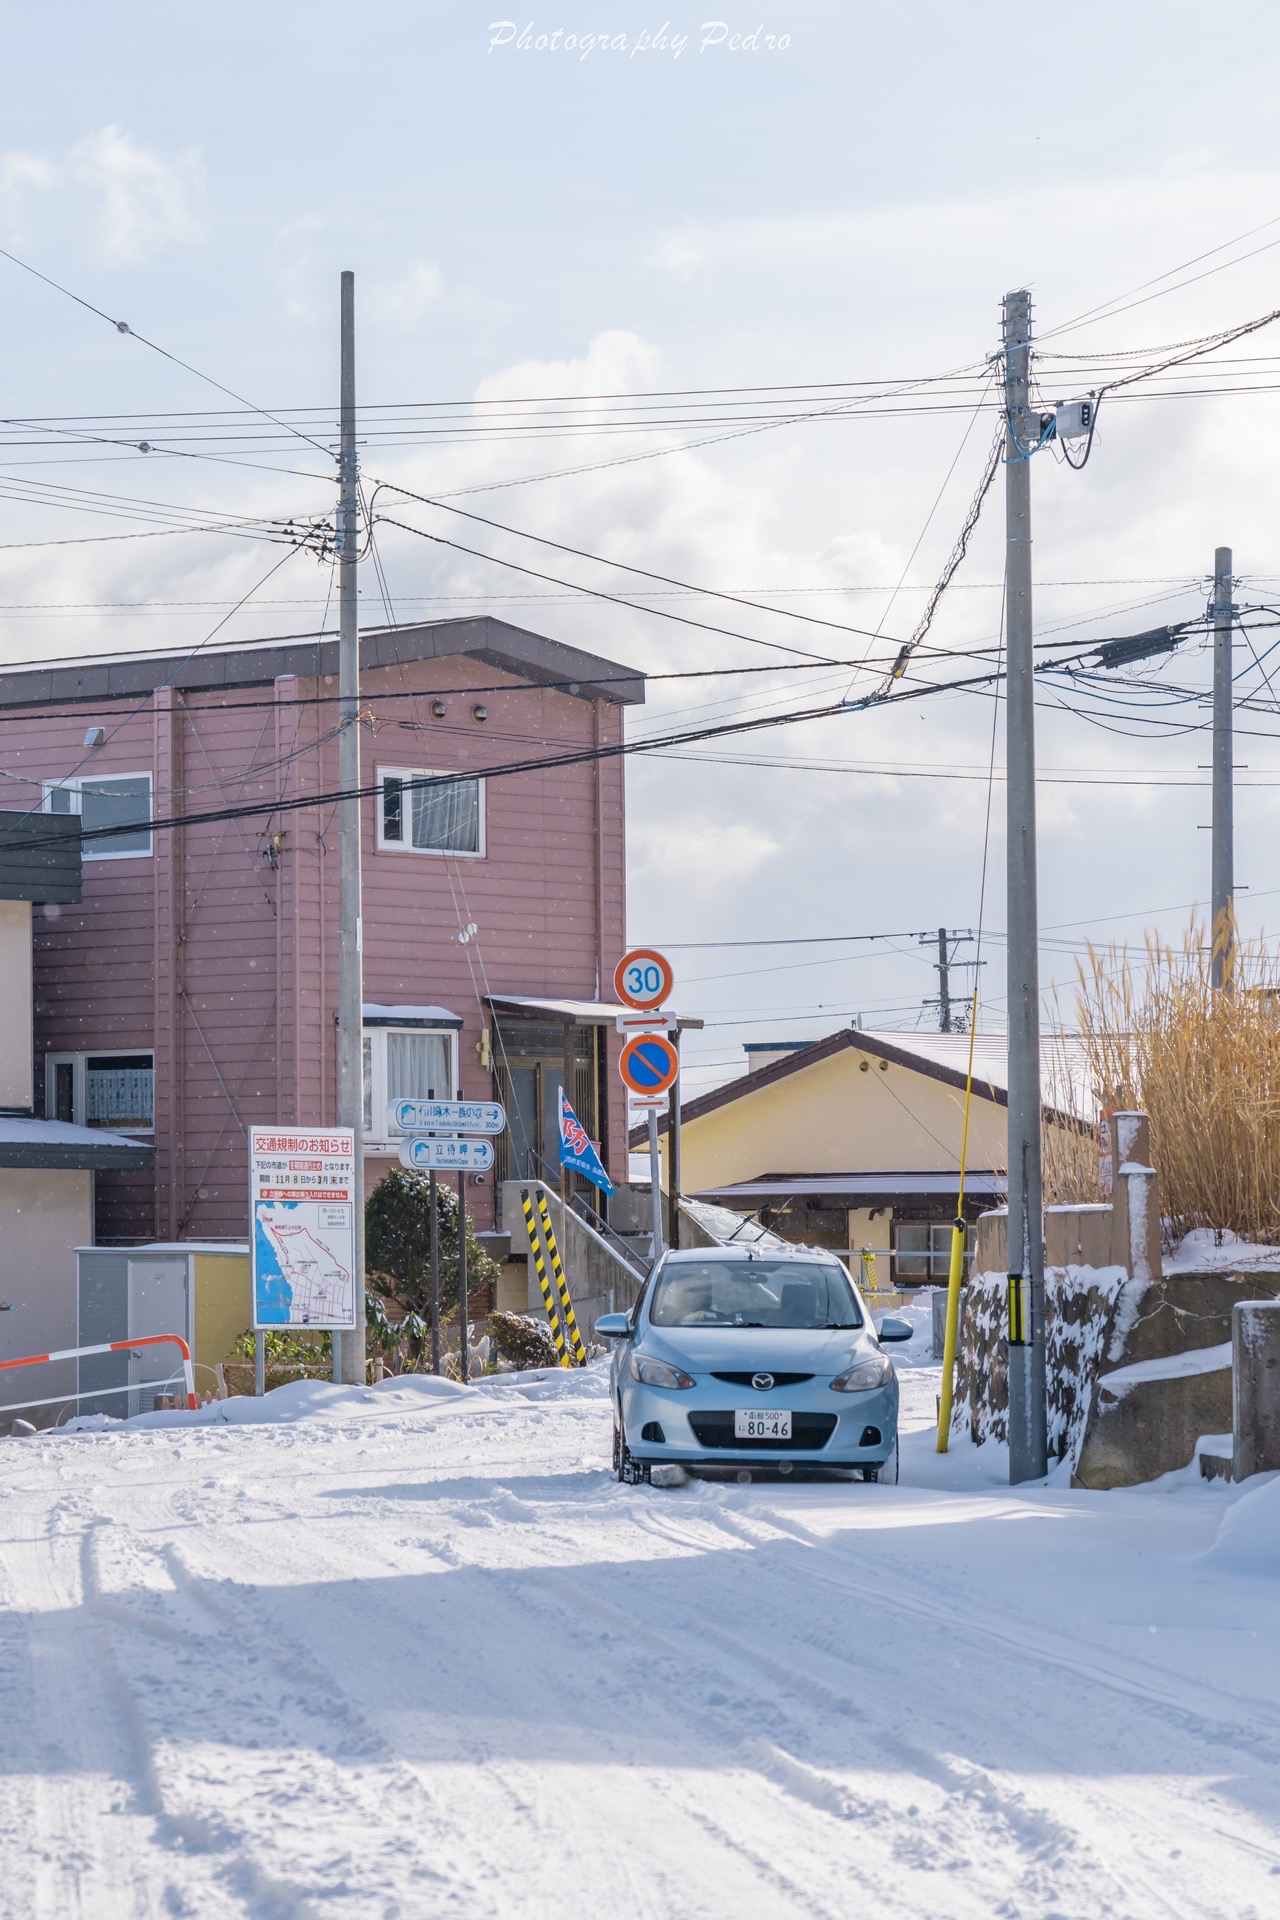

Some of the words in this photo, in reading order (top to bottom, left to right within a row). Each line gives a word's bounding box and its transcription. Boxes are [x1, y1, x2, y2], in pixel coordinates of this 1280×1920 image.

[628, 965, 660, 994] 30
[485, 1121, 499, 1129] 300m
[255, 1137, 350, 1153] 交通規制のお知らせ
[765, 1412, 779, 1420] 500
[748, 1421, 788, 1436] 80-46
